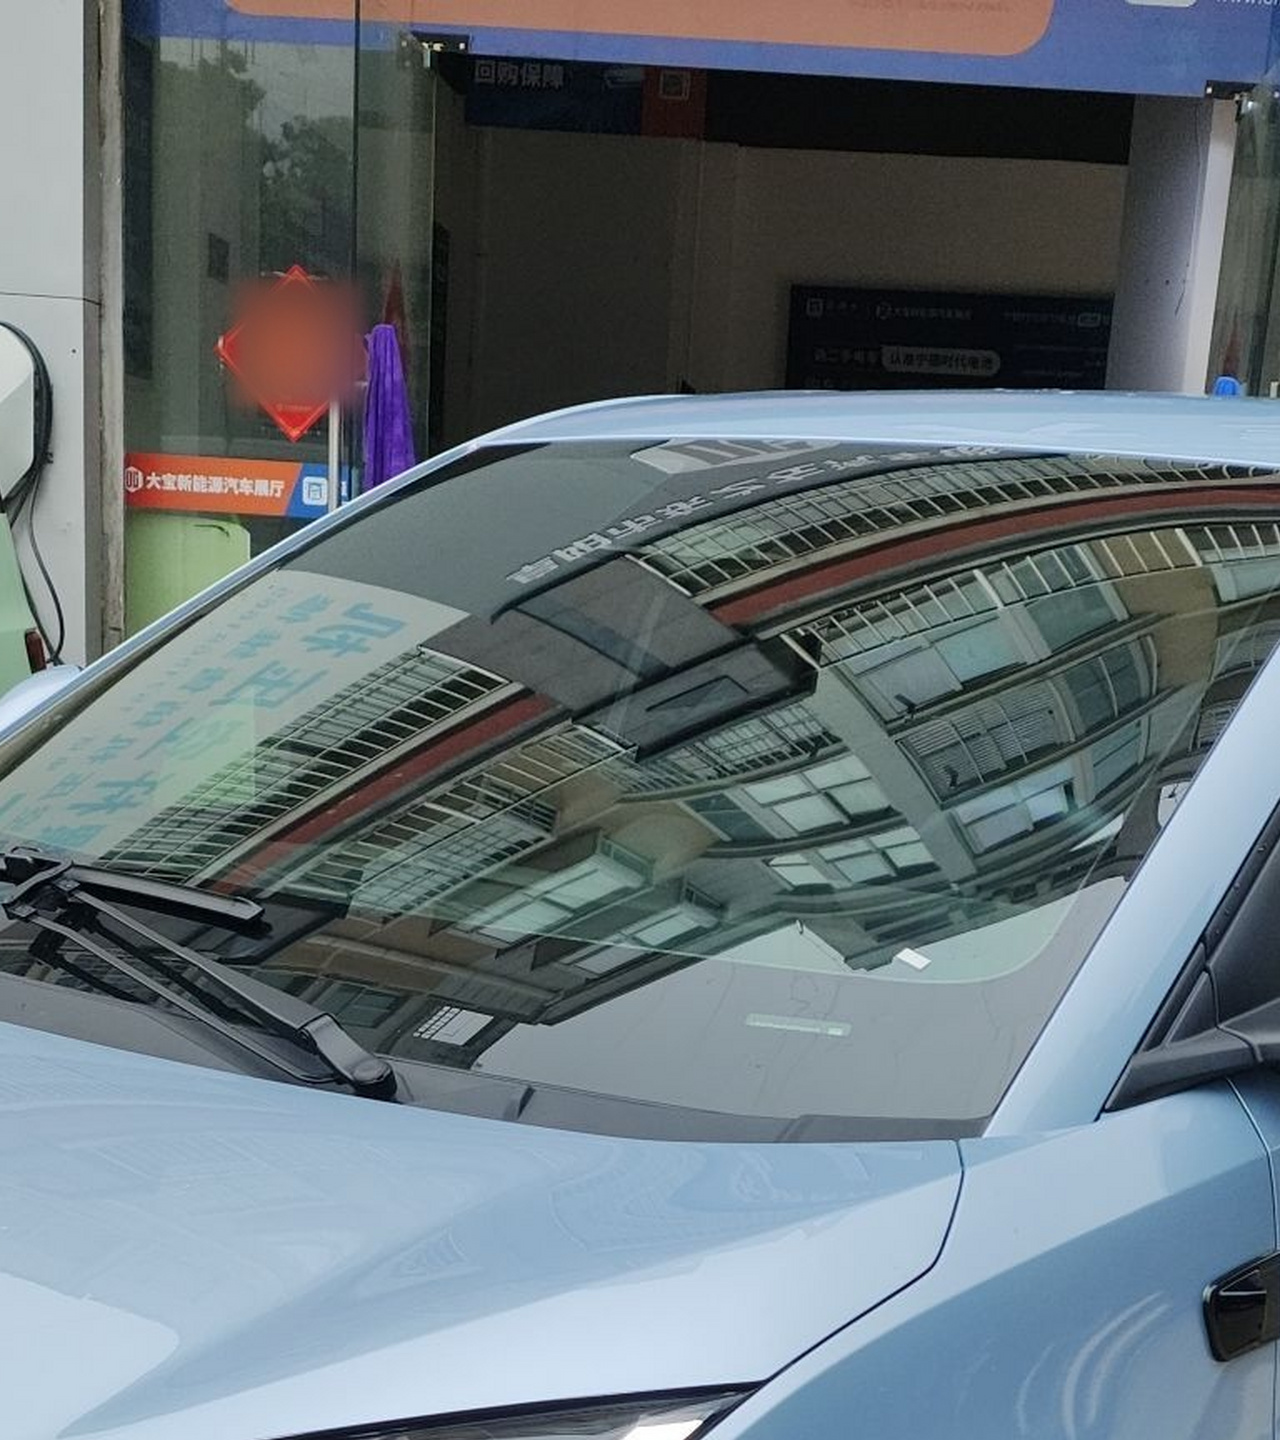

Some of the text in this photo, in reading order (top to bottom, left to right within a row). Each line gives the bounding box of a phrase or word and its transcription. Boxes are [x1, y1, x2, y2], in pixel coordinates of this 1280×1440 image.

[474, 60, 564, 90] 回购保障
[146, 472, 285, 498] 大宝新能源汽车展厅
